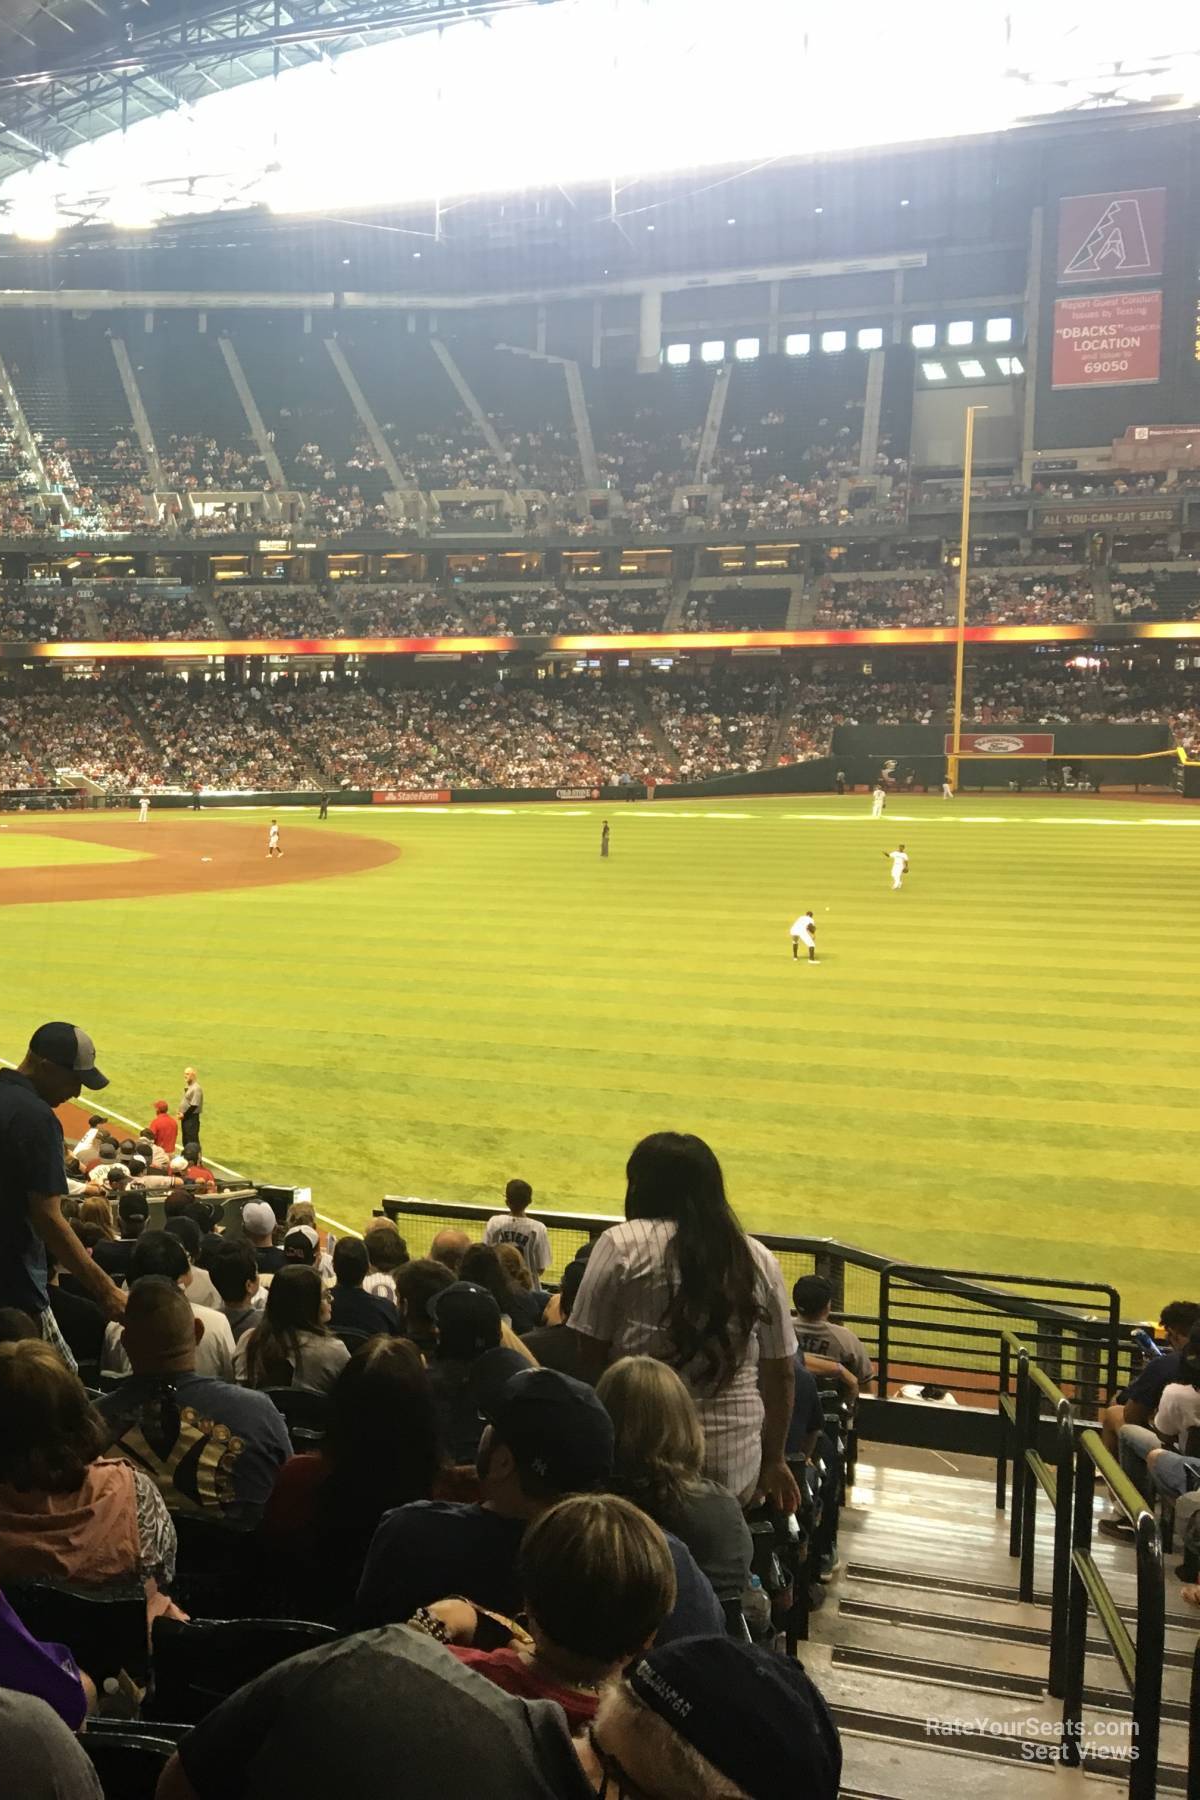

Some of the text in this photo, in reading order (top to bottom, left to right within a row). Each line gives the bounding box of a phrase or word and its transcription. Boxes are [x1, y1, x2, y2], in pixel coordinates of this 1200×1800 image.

[1073, 336, 1141, 352] LOCATION
[1084, 360, 1129, 373] 69050
[1139, 510, 1173, 522] SEATS
